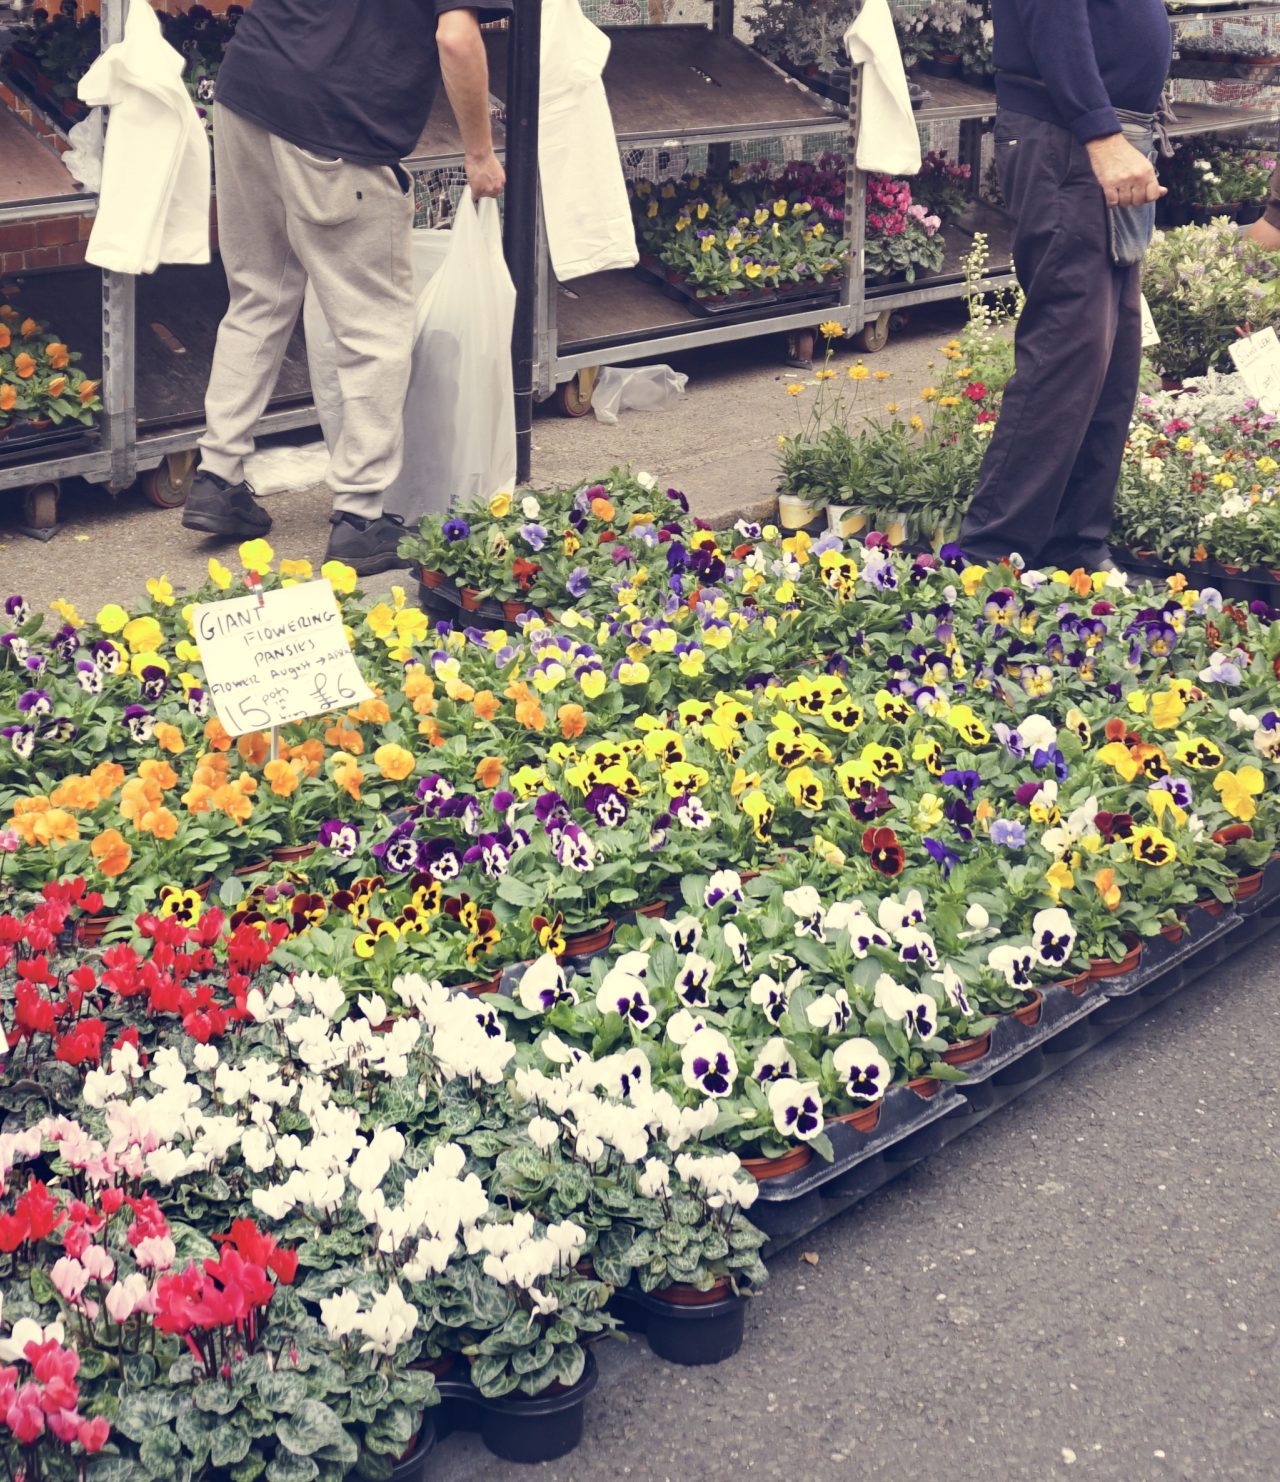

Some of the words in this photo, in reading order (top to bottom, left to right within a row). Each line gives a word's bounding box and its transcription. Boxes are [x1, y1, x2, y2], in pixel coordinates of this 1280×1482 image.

[200, 606, 265, 641] GIANT
[253, 639, 316, 668] PANSIES
[309, 672, 357, 710] £6
[224, 696, 272, 732] 15
